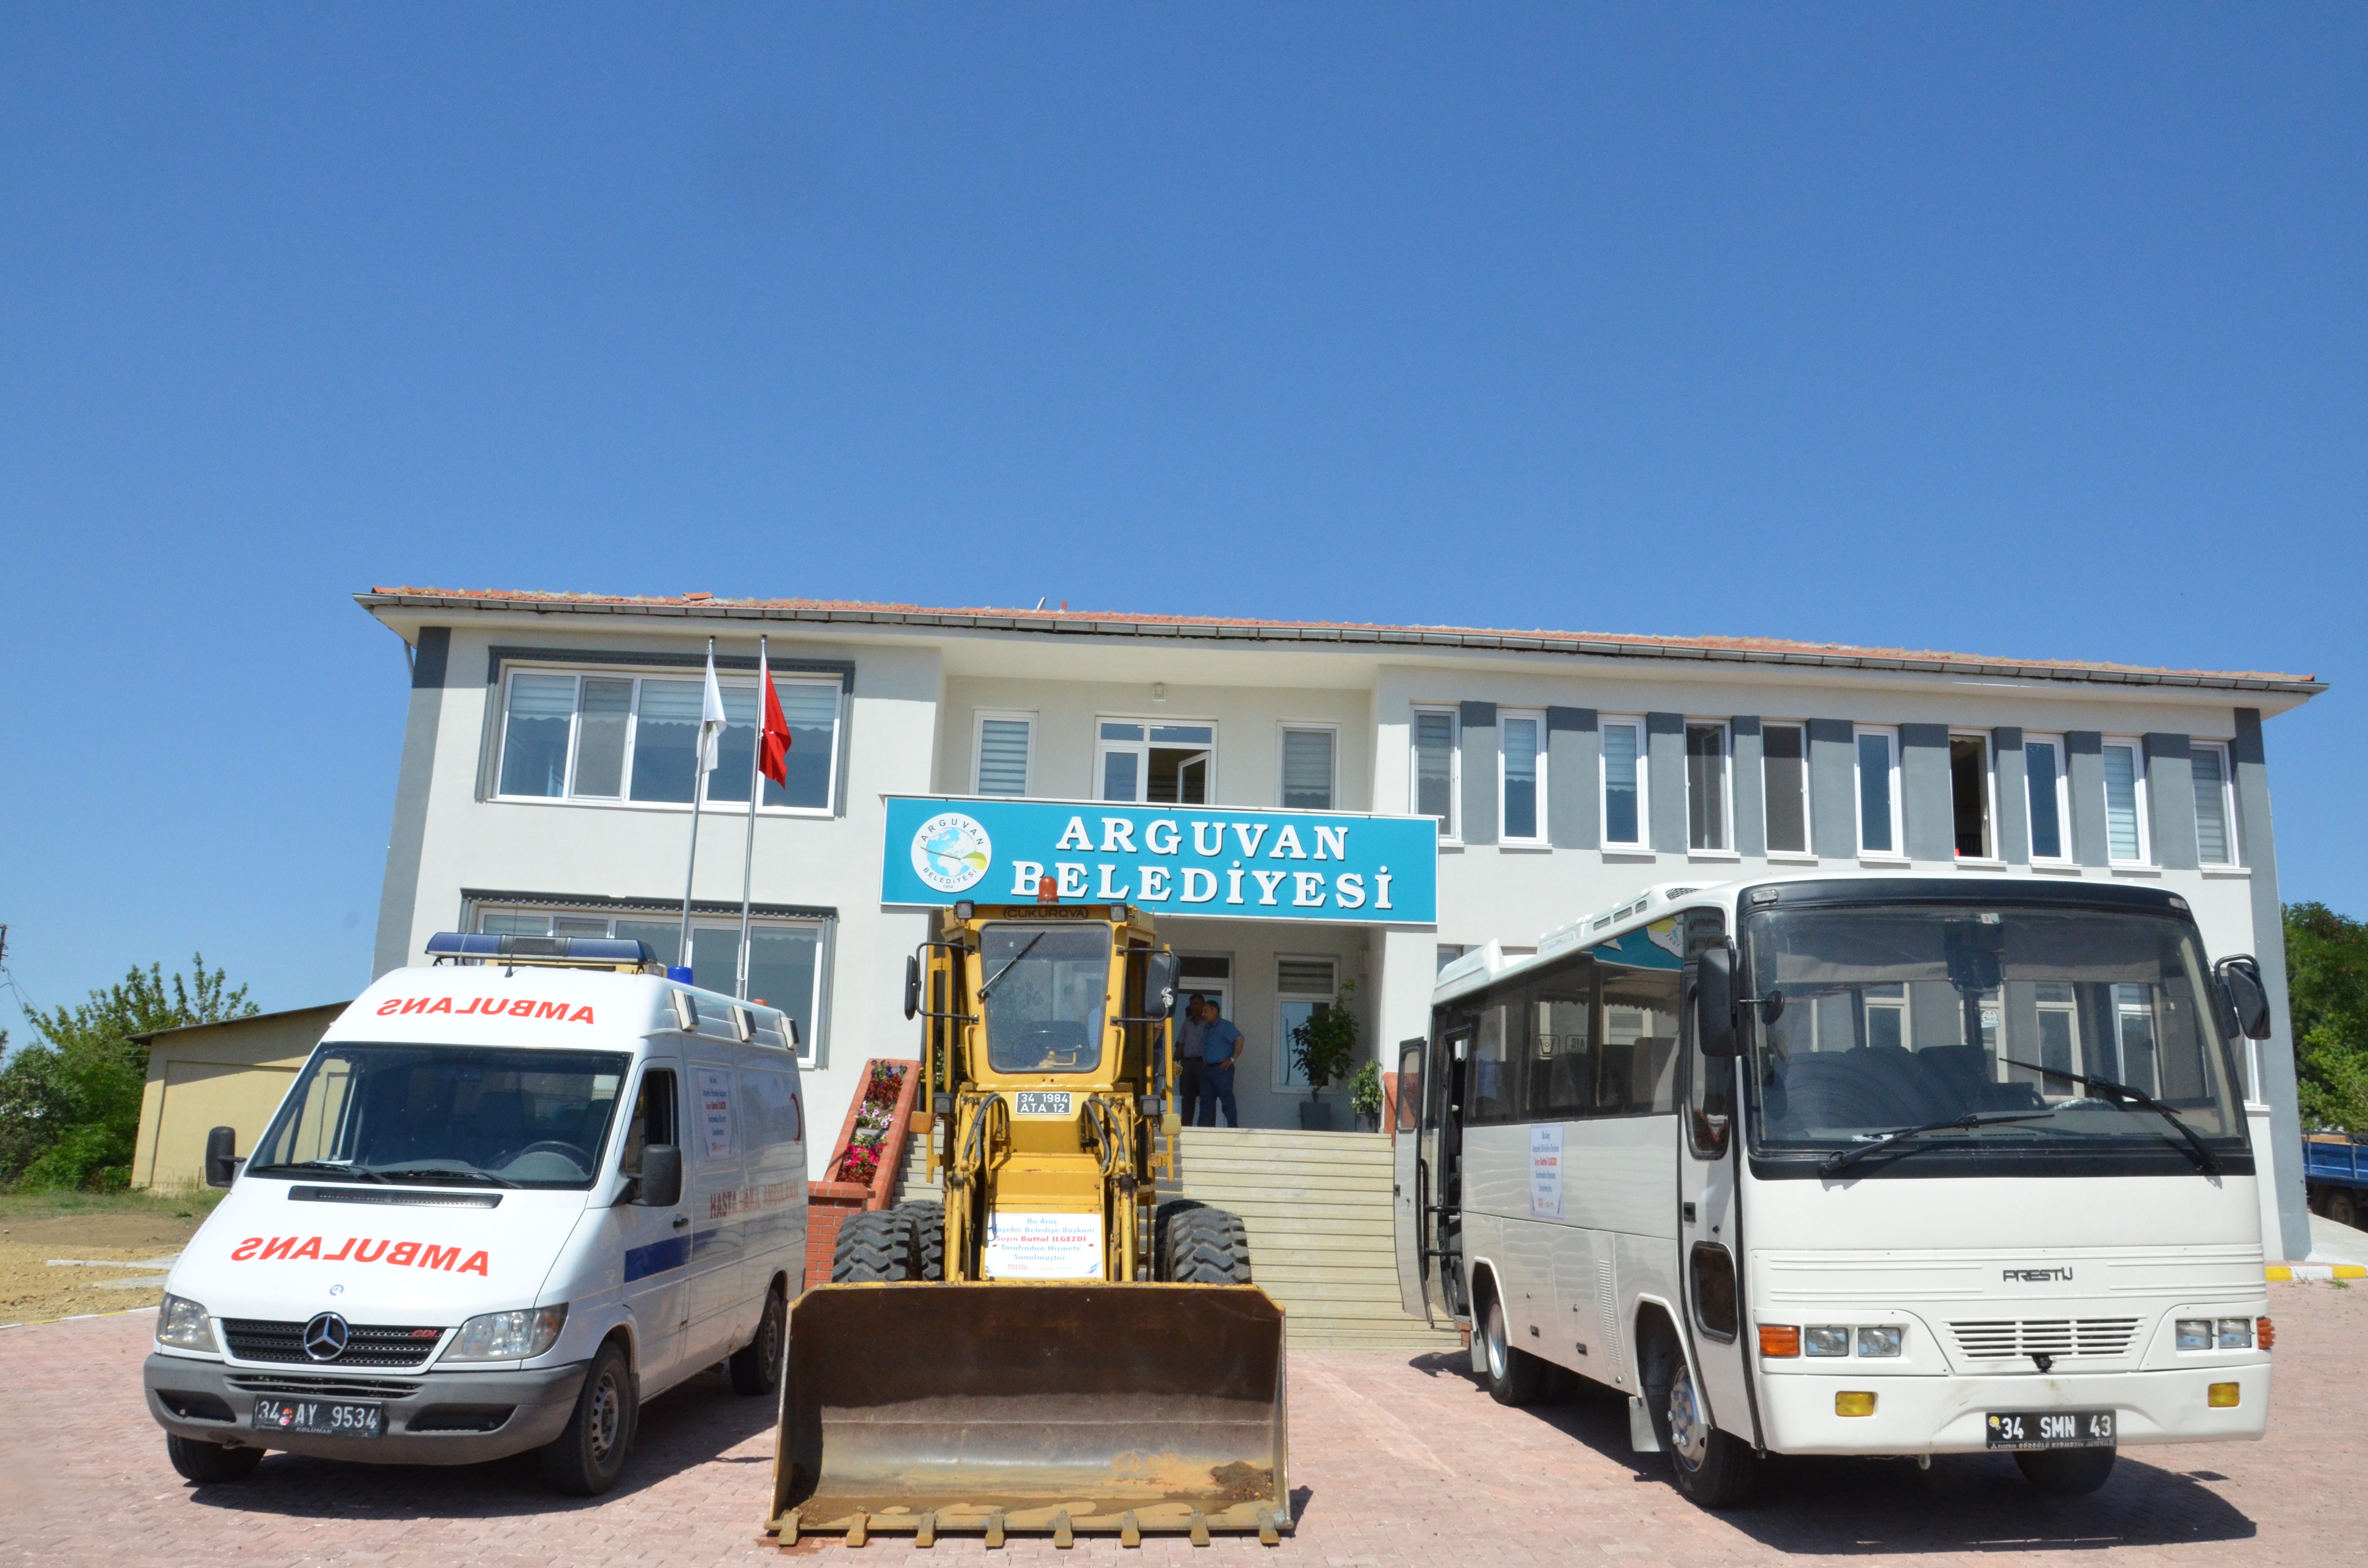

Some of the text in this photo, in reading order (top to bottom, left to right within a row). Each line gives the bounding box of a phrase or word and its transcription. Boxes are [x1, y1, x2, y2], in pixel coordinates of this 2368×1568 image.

[921, 818, 984, 845] ARGUVAN
[1056, 816, 1347, 861] ARGUVAN
[1011, 860, 1392, 909] BELEDİYESİ
[1020, 1103, 1065, 1112] ATA 12
[1021, 1093, 1068, 1103] 34 1984
[412, 1329, 437, 1337] CDI
[259, 1401, 377, 1429] 34 AY 9534
[2001, 1415, 2111, 1439] 34 SMN 43
